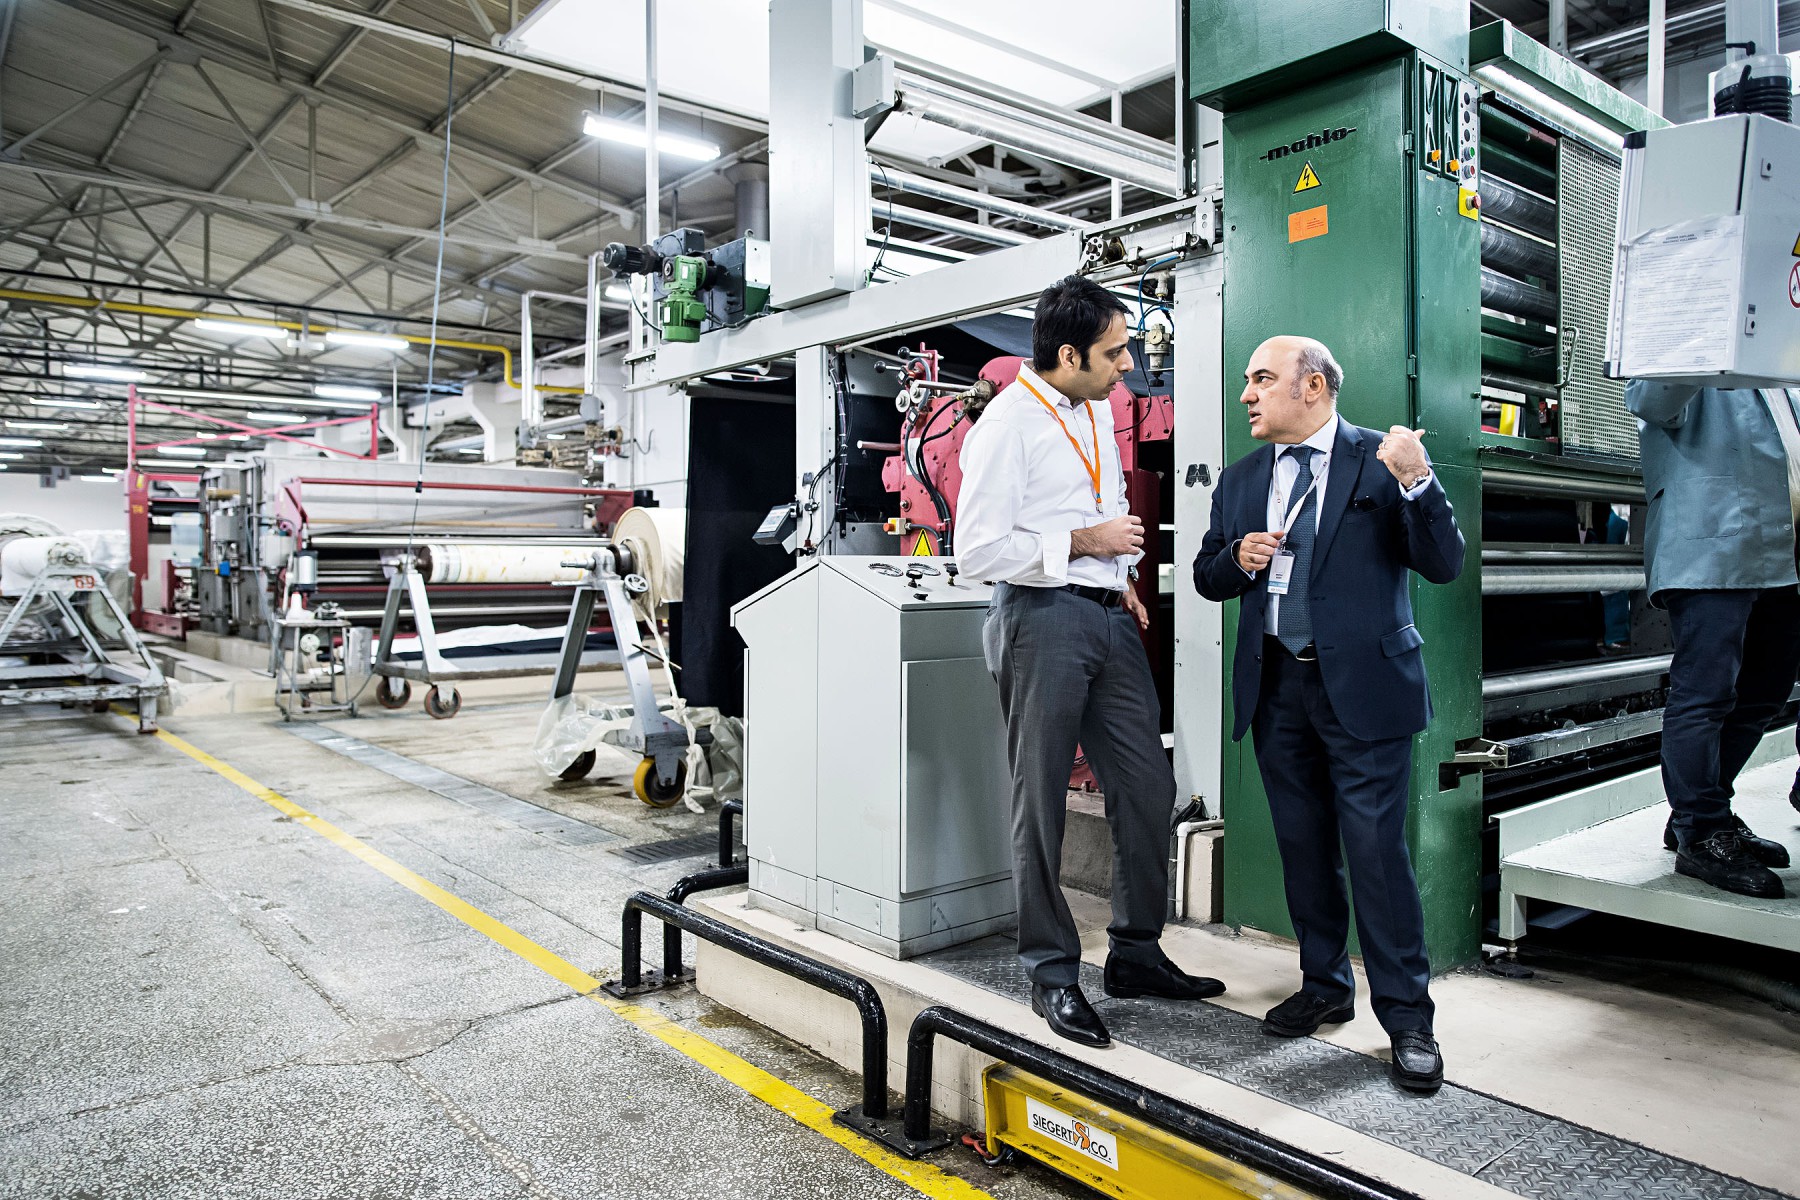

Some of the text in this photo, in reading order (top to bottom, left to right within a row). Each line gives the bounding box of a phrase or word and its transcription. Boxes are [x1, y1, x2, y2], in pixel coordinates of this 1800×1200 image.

[1266, 127, 1348, 161] mahlo
[75, 575, 95, 589] 69
[1032, 1114, 1073, 1142] SIEGERT
[1091, 1141, 1112, 1161] CO.
